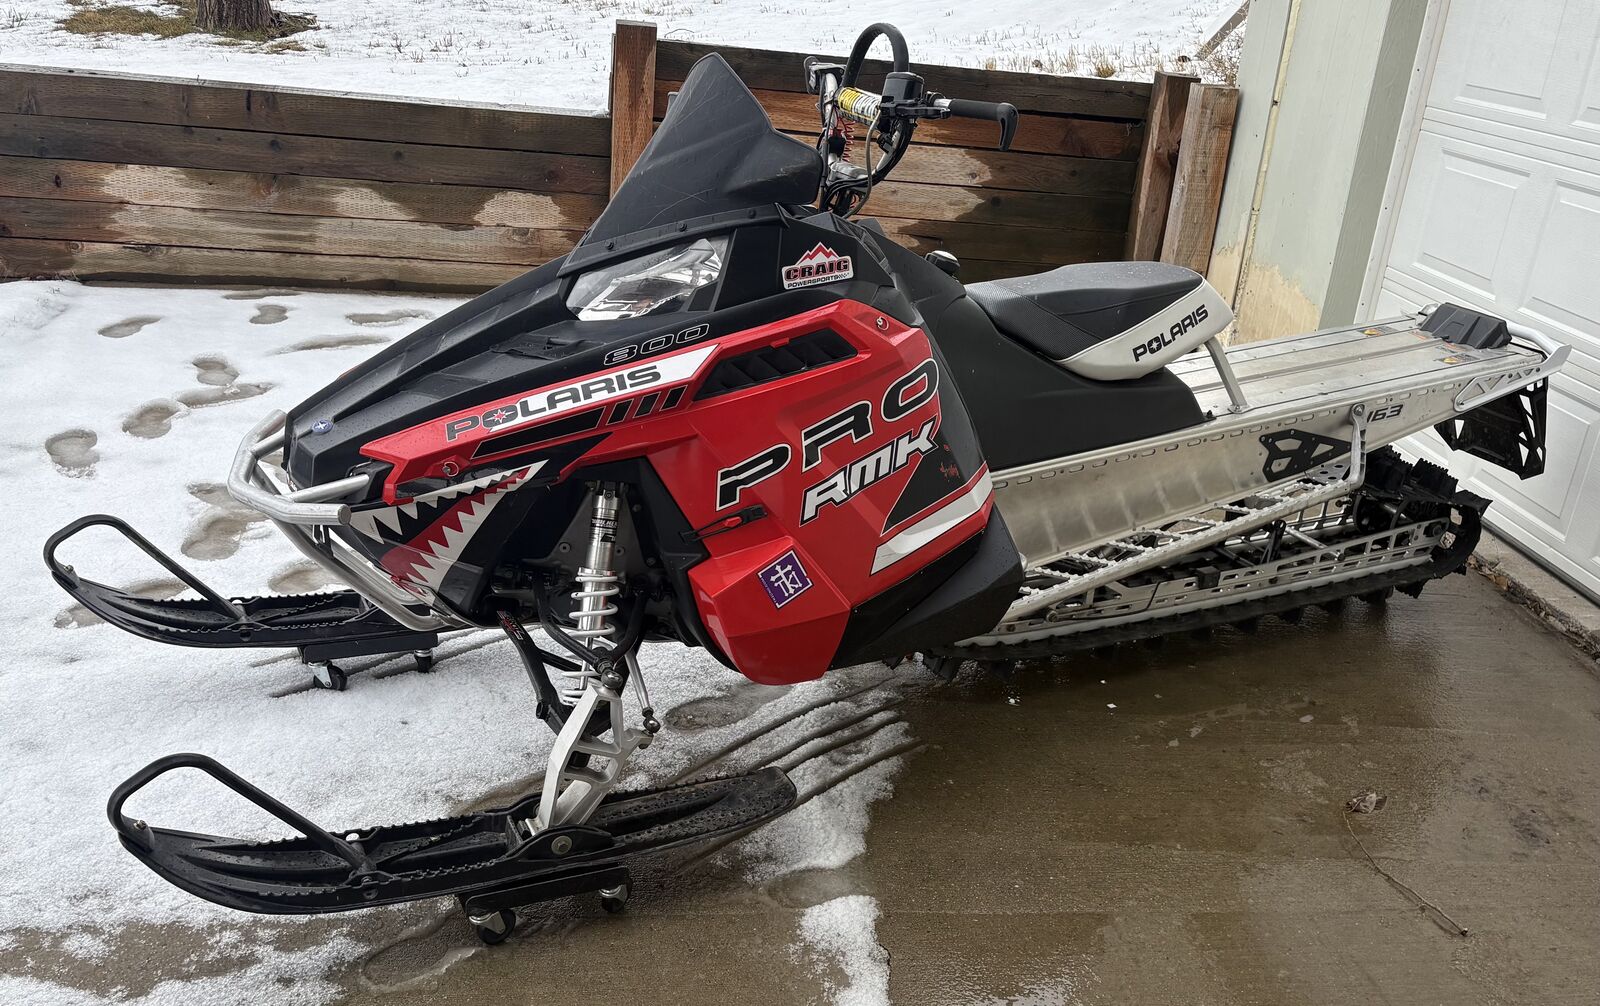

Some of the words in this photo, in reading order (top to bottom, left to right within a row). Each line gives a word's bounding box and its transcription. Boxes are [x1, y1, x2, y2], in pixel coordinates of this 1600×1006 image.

[784, 258, 850, 282] CRAIG
[787, 274, 839, 289] POWERSPORTS
[604, 323, 710, 366] 800
[1132, 303, 1209, 363] POLARIS
[444, 364, 662, 443] POLARIS
[1366, 403, 1404, 424] 163
[716, 357, 940, 512] PRO
[800, 415, 939, 528] RMK
